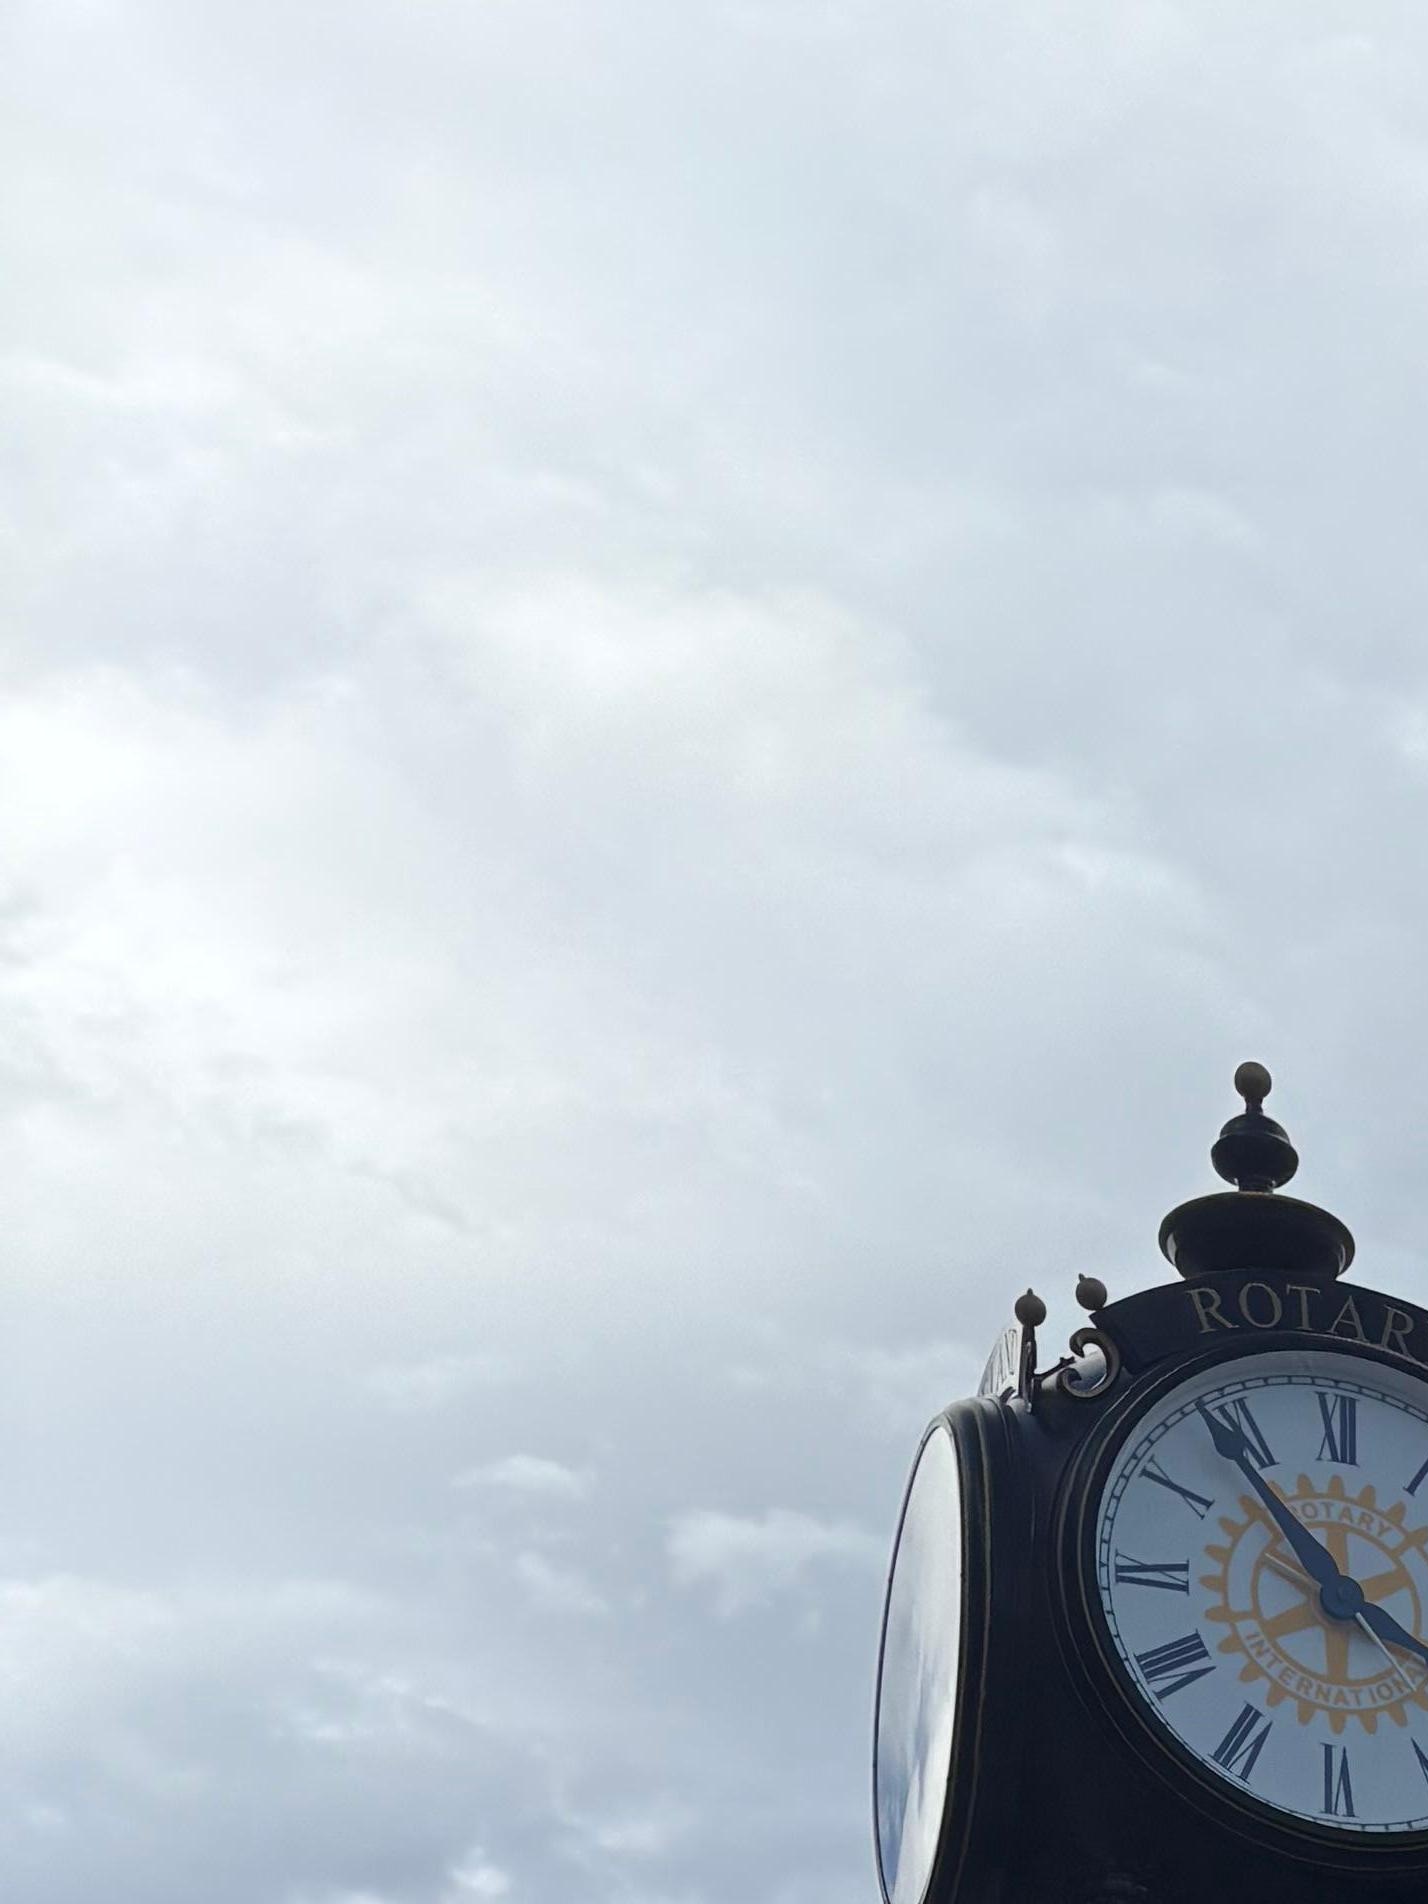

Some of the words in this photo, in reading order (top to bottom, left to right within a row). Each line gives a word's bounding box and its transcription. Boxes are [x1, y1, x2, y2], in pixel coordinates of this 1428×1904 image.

[1315, 1391, 1359, 1467] XII
[1139, 1453, 1215, 1520] X
[1114, 1549, 1190, 1596] IX
[1133, 1628, 1217, 1704] VIII
[1245, 1632, 1426, 1706] INTERNATIONA
[1207, 1701, 1273, 1784] VII
[1320, 1742, 1358, 1818] VI
